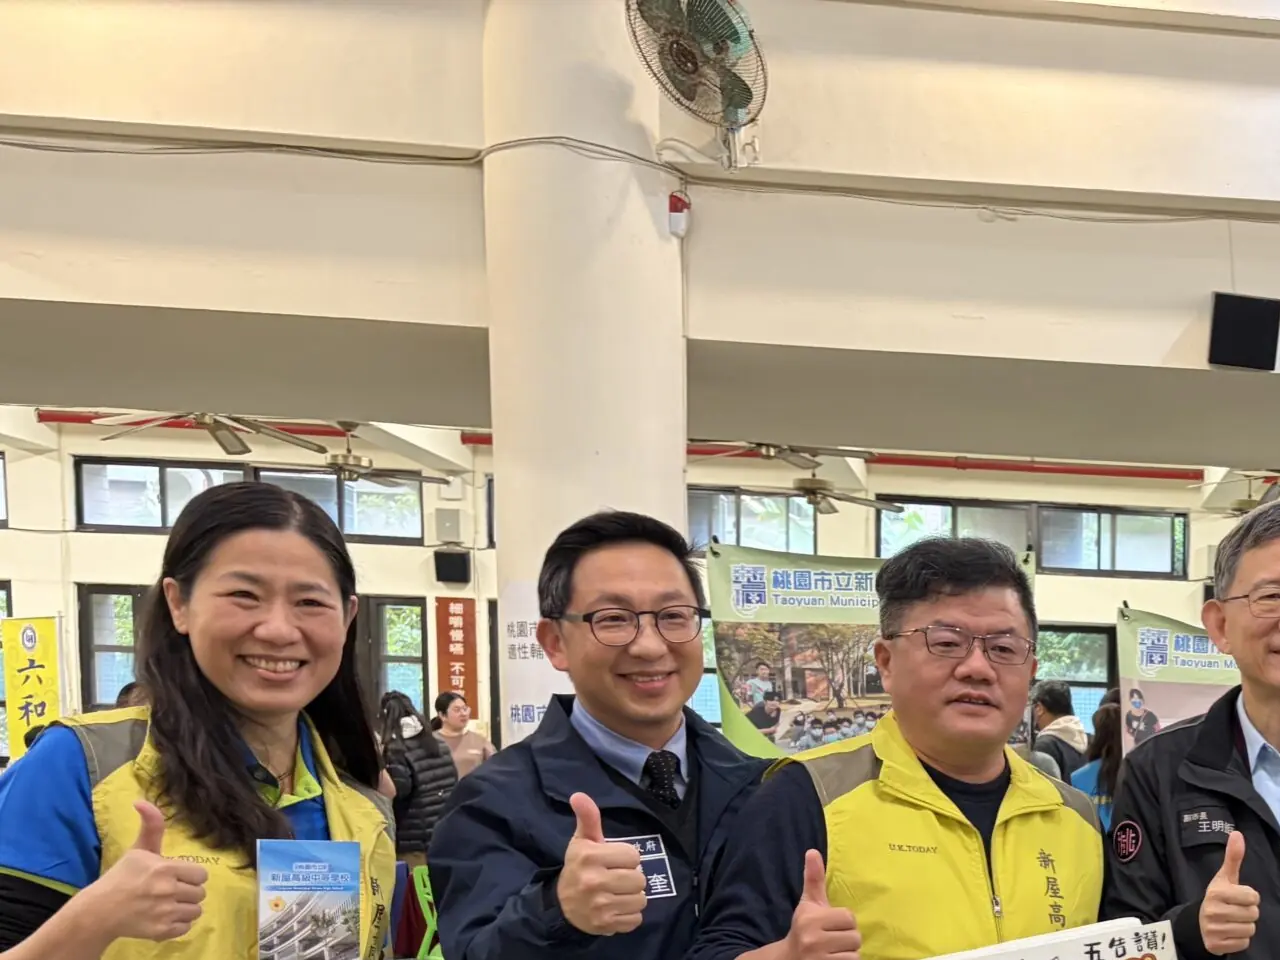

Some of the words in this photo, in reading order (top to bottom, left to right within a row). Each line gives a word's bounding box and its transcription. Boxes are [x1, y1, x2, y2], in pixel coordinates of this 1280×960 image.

[772, 570, 874, 592] 桃園市立新
[773, 594, 825, 607] Taoyuan
[830, 594, 879, 609] Municip
[1174, 655, 1219, 669] Taoyuan
[16, 658, 47, 728] 六和
[888, 843, 939, 855] U.K.TODAY
[1036, 848, 1066, 932] 新屋高
